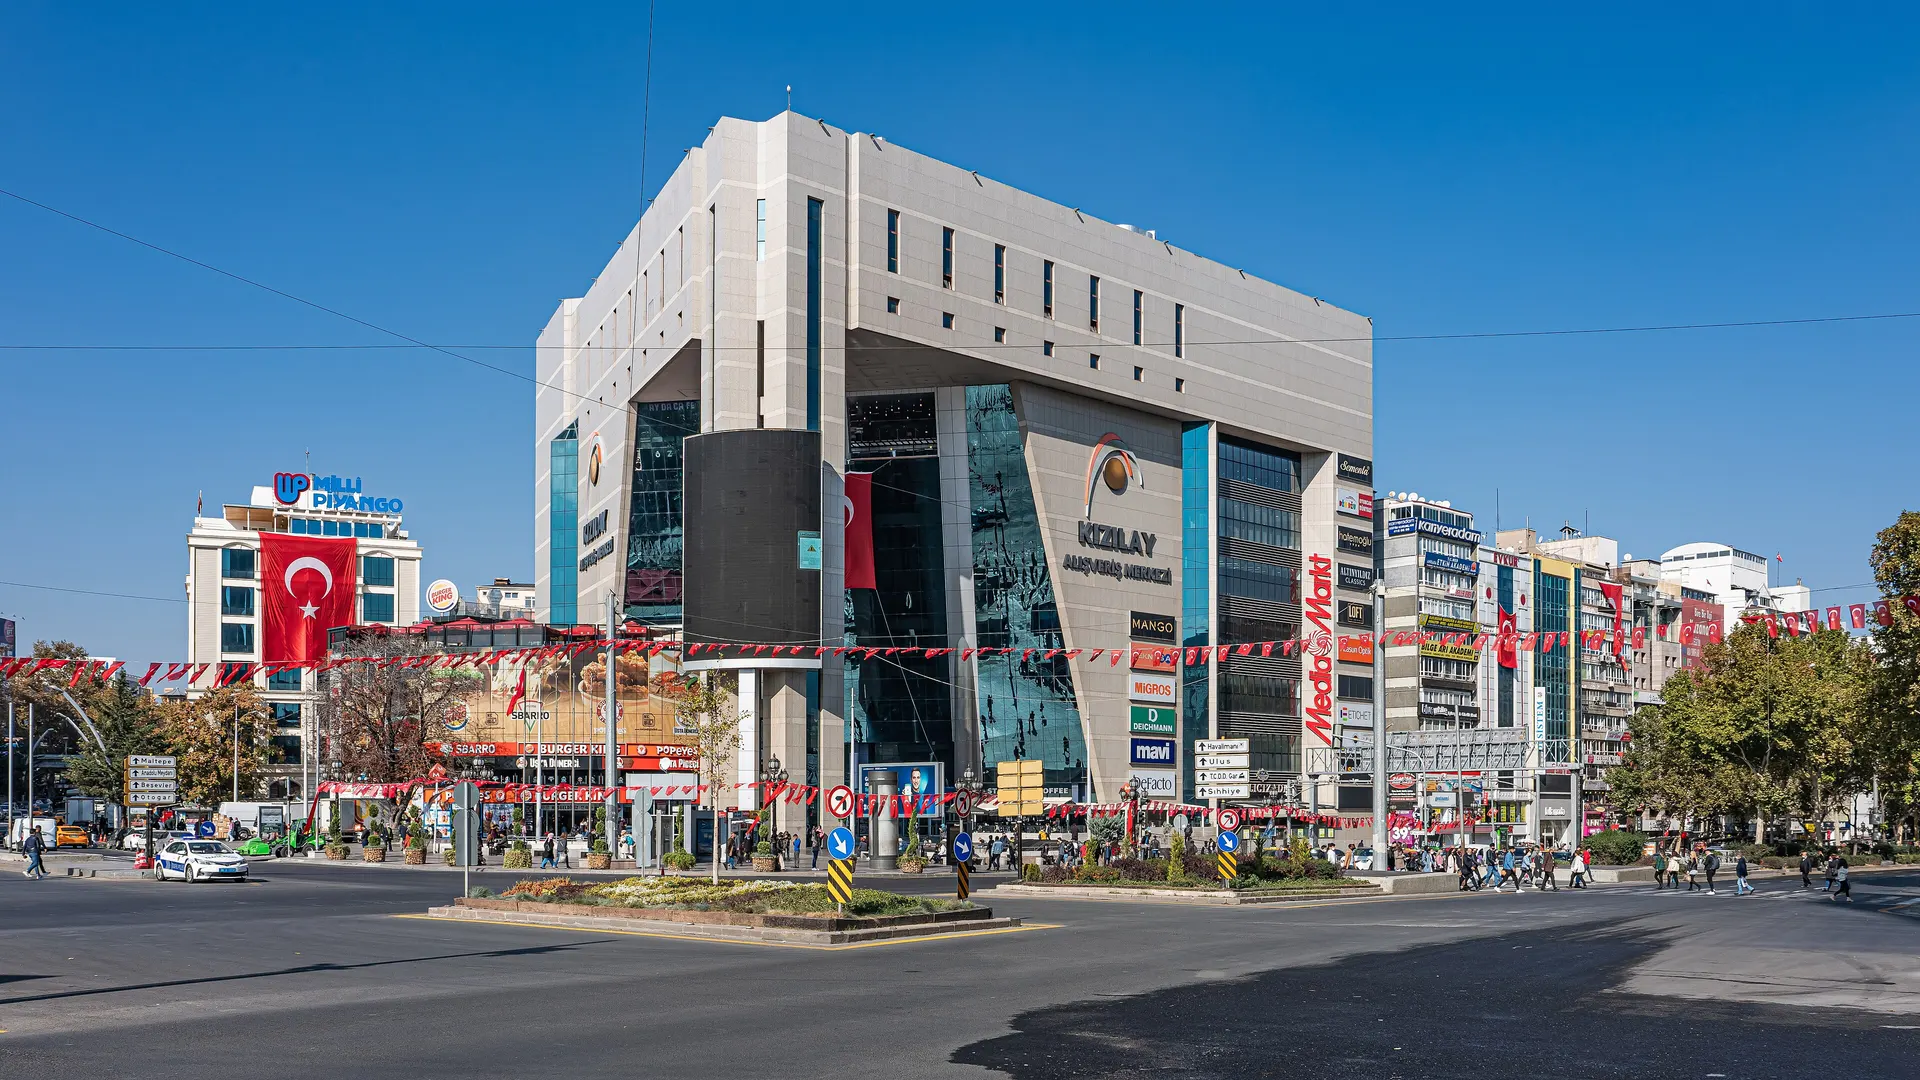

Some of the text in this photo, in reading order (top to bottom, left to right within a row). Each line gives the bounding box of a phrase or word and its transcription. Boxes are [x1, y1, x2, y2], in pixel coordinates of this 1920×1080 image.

[1078, 520, 1157, 558] KIZILAY
[431, 587, 452, 598] BURGER
[432, 592, 453, 605] KING
[1132, 618, 1173, 633] MANGO
[1305, 553, 1332, 747] Media Markt
[1148, 708, 1158, 723] D
[1133, 723, 1173, 733] DEICHMANN
[455, 744, 496, 754] SBARRO
[541, 744, 587, 754] BURGER
[1136, 742, 1170, 760] mavi
